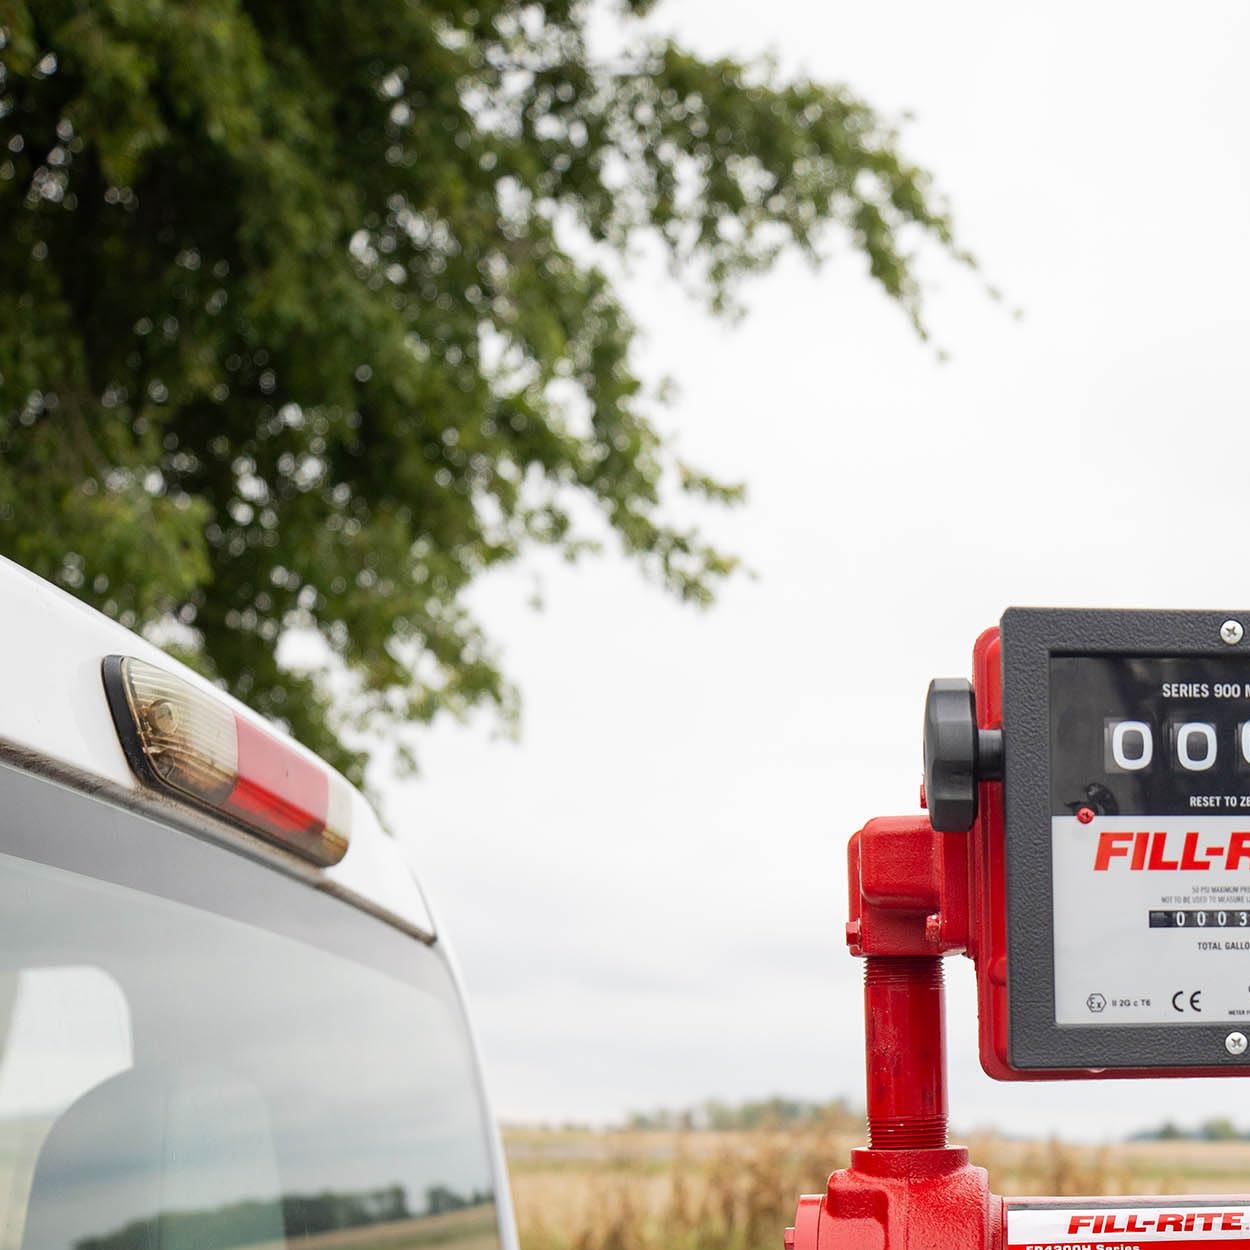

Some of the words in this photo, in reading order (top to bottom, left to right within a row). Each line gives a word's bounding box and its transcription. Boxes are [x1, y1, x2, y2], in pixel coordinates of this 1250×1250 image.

[1162, 683, 1209, 697] SERIES
[1214, 684, 1240, 697] 900
[1189, 796, 1221, 807] RESET
[1224, 796, 1237, 807] TO
[1161, 896, 1173, 904] NOT
[1174, 896, 1180, 904] TO
[1183, 896, 1191, 904] BE
[1192, 896, 1208, 904] USED
[1197, 942, 1222, 950] TOTAL
[1172, 990, 1202, 1012] CE
[1067, 1212, 1244, 1234] FILL-RITE
